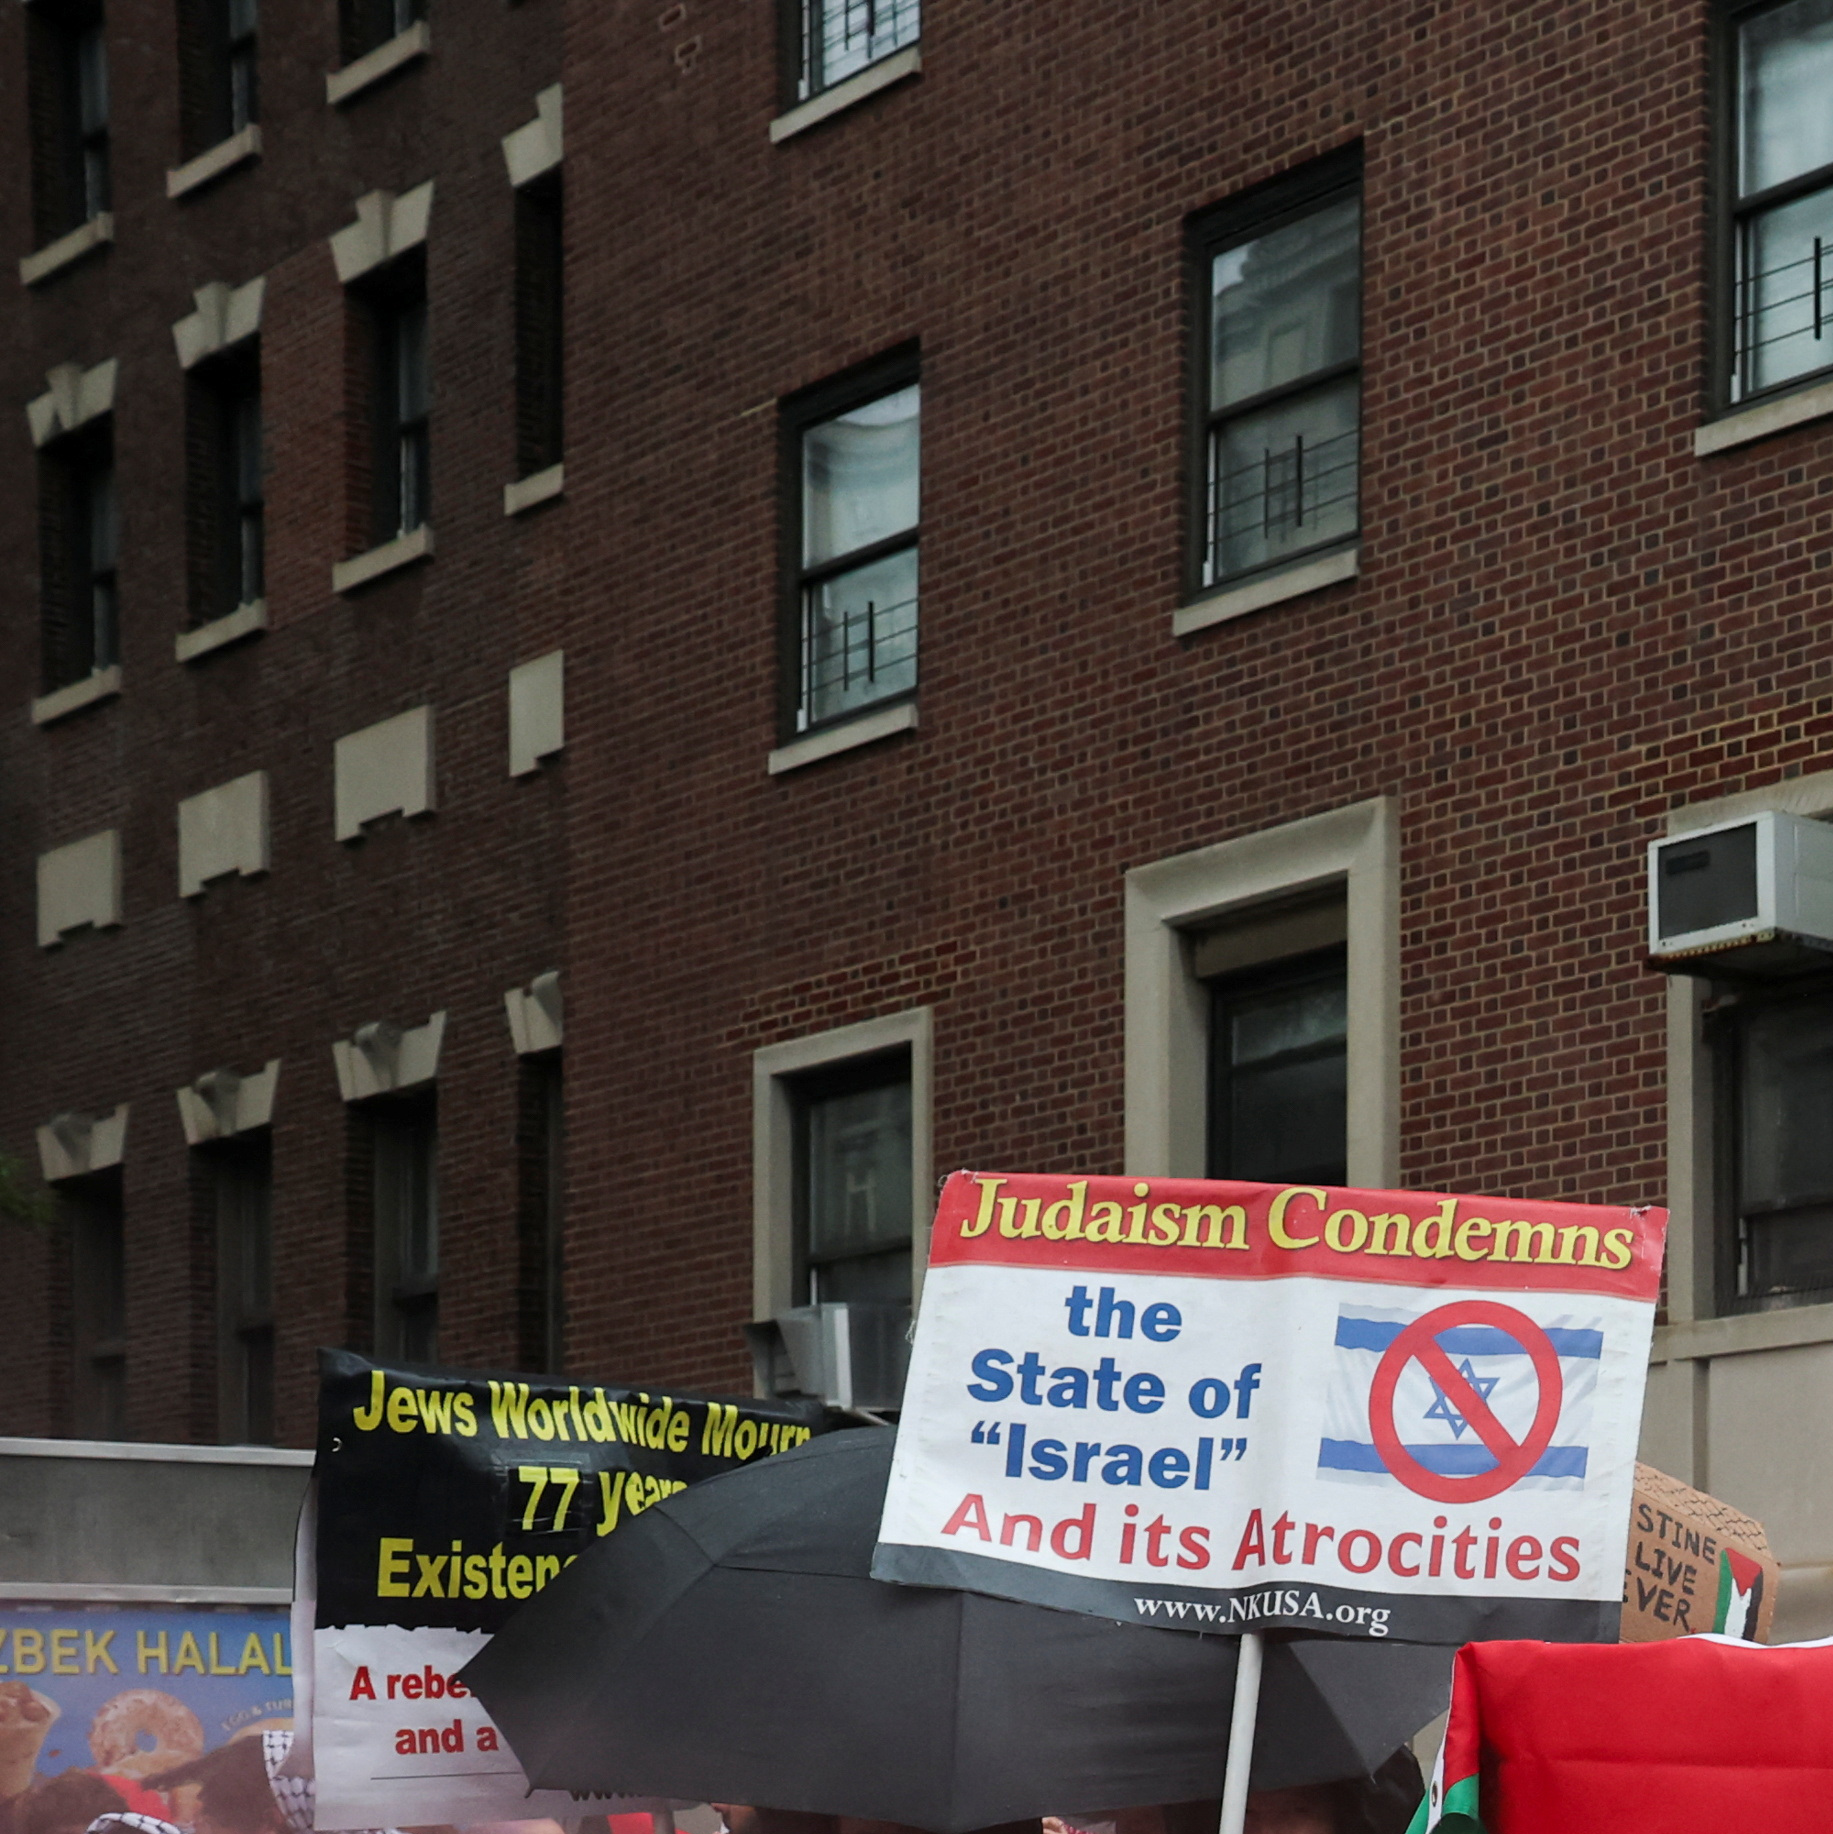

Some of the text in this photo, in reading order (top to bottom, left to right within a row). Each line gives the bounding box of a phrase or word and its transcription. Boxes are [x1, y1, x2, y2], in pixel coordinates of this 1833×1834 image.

[959, 1177, 1636, 1271] Judaism Condemns
[1064, 1285, 1182, 1344] the
[353, 1370, 478, 1437] Jews
[488, 1380, 690, 1452] Worldwide
[967, 1348, 1263, 1420] State of
[518, 1466, 579, 1532] 77
[377, 1538, 579, 1600] Existen
[941, 1493, 1582, 1583] And its Atrocities
[1635, 1541, 1698, 1596] LIVE
[1134, 1590, 1391, 1637] www.NKUSA.org
[1623, 1568, 1692, 1633] VER
[136, 1630, 292, 1676] HALAL
[349, 1665, 478, 1701] A rebe
[395, 1719, 464, 1754] and
